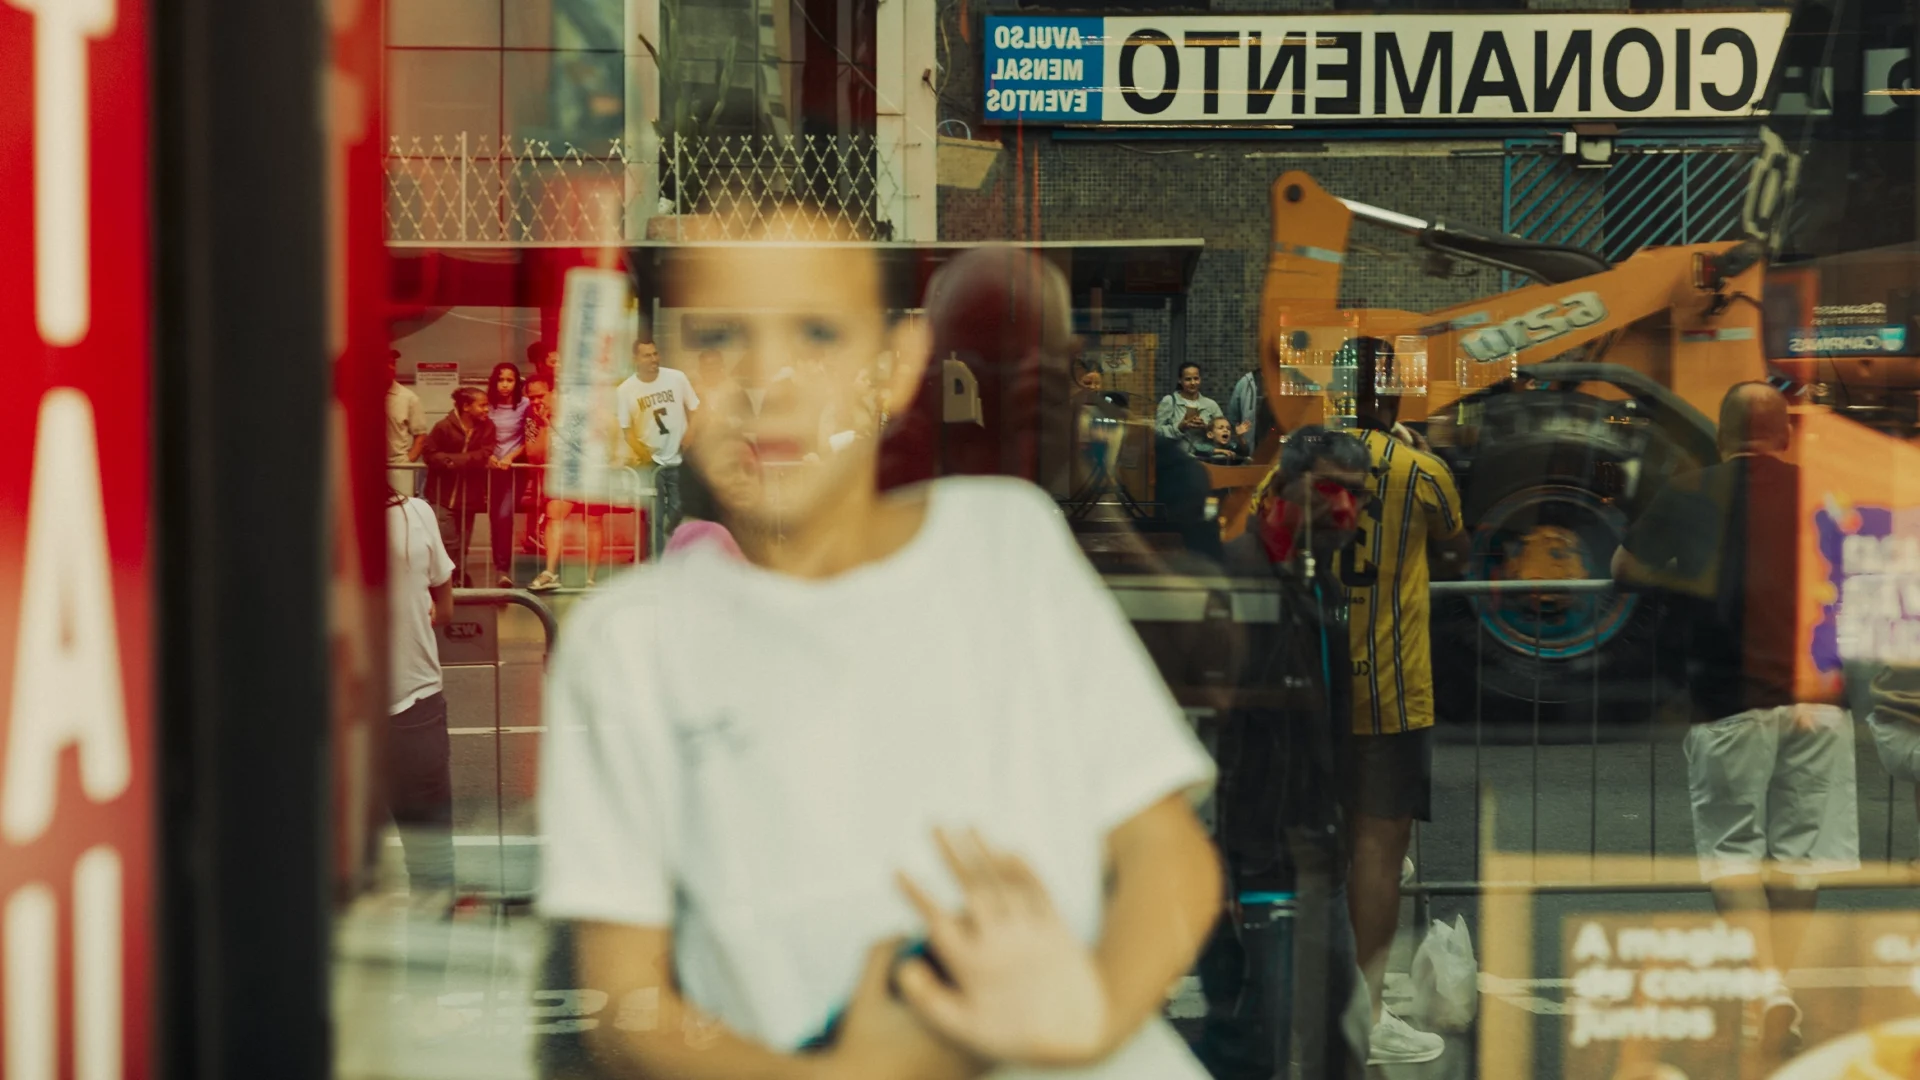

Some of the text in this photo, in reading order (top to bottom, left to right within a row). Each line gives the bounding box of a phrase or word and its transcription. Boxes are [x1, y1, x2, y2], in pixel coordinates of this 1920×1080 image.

[1573, 920, 1755, 968] A magia
[1570, 1004, 1715, 1047] juntos
